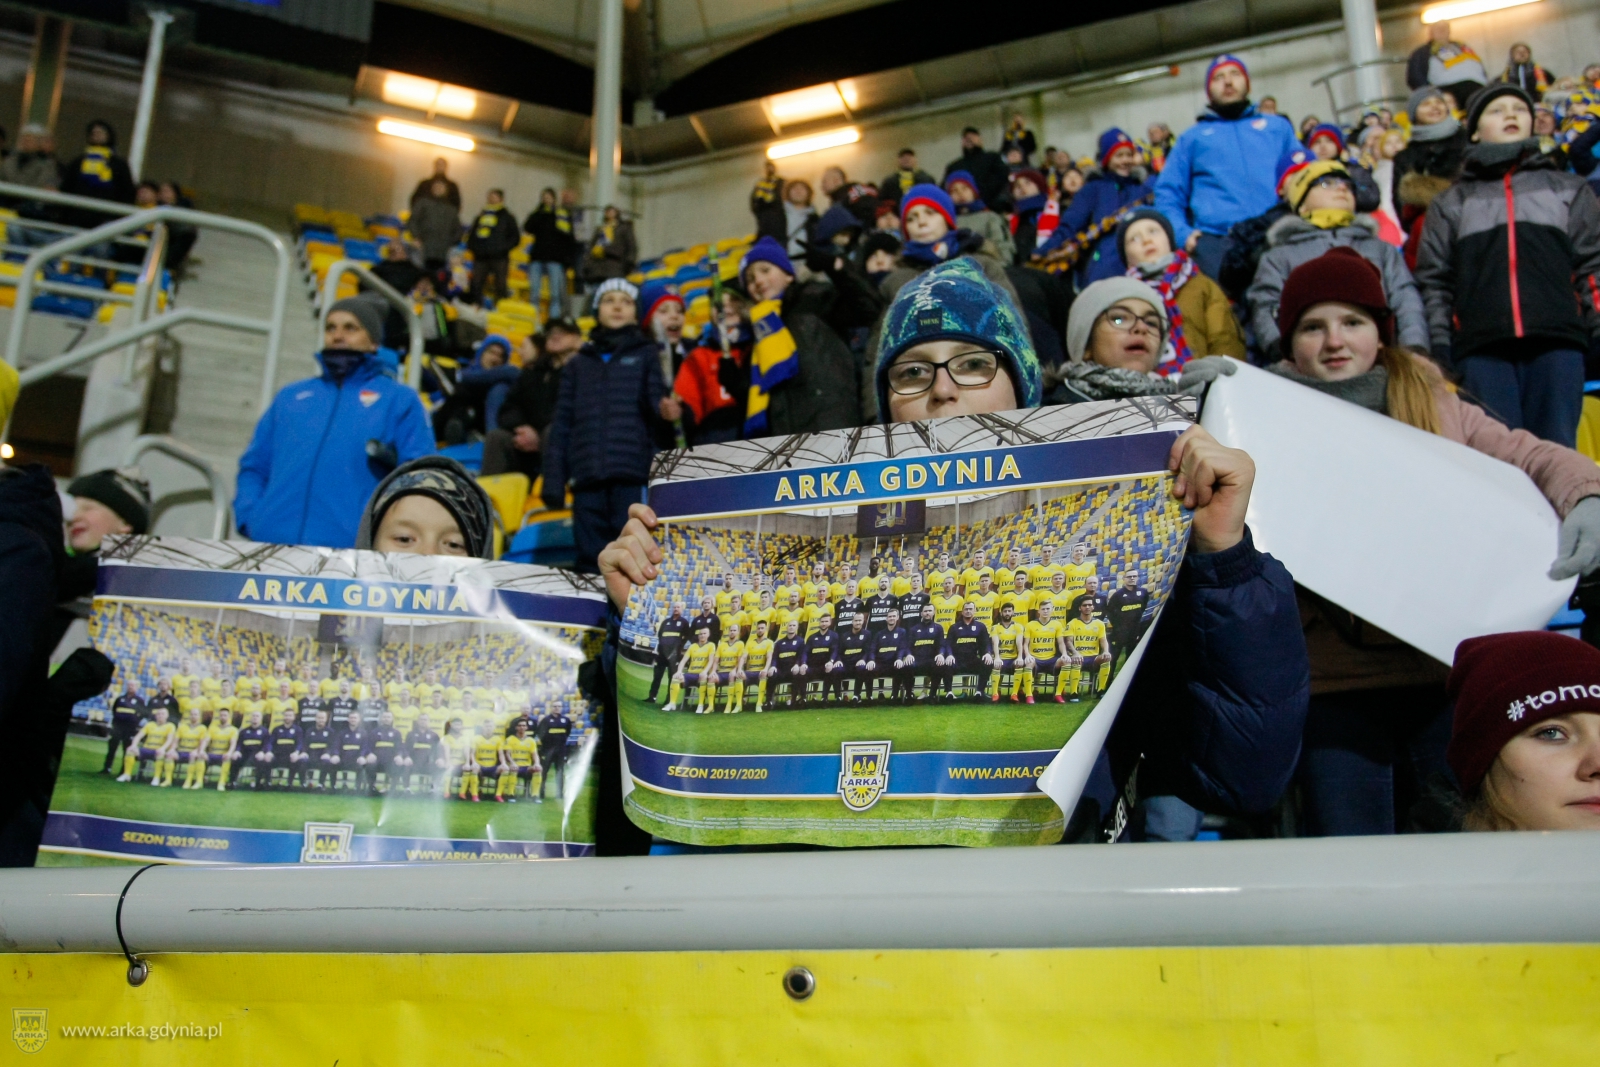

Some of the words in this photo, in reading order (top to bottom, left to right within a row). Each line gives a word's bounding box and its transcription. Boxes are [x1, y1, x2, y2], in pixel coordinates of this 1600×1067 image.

[774, 469, 865, 502] ARKA
[879, 454, 1022, 492] GDYNIA
[238, 577, 329, 604] ARKA
[342, 584, 470, 612] GDYNIA
[667, 765, 708, 779] SEZON
[709, 768, 768, 780] 2019/2020
[847, 778, 878, 786] ARKA
[122, 831, 165, 846] SEZON
[166, 835, 230, 850] 2019/2020
